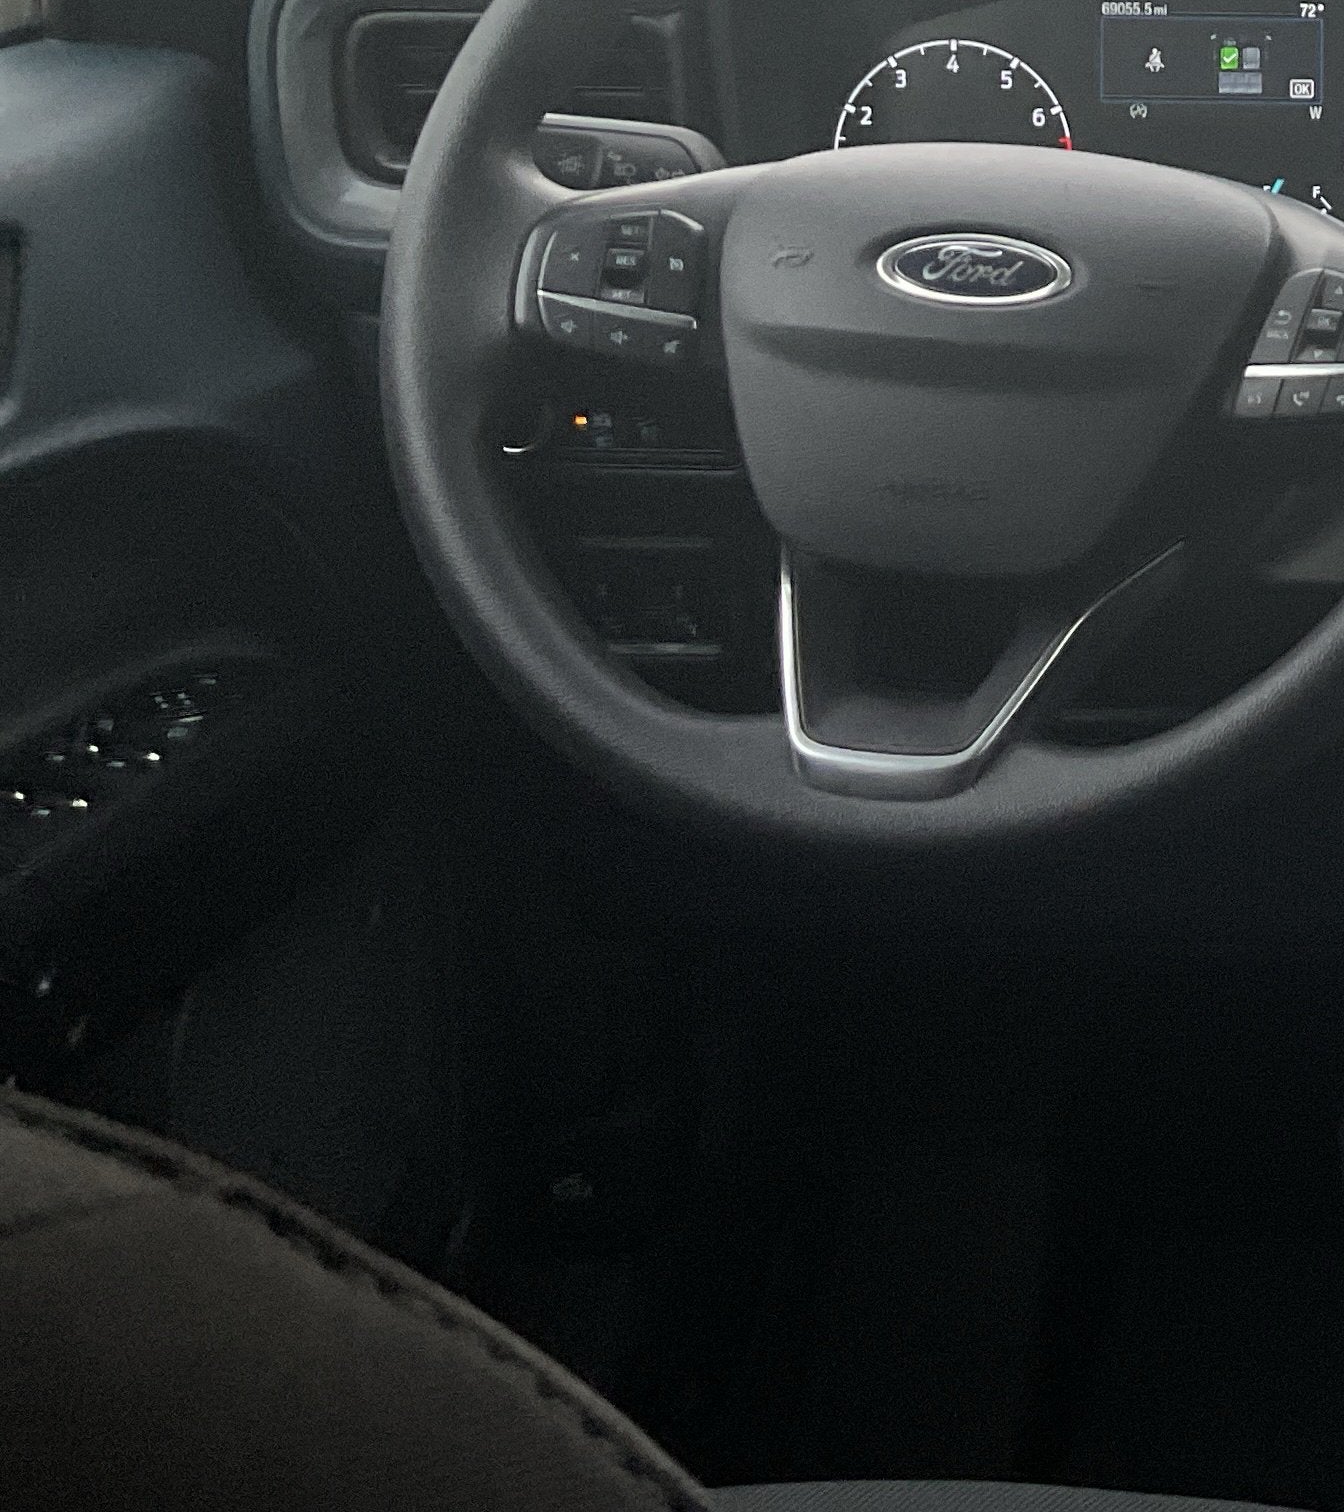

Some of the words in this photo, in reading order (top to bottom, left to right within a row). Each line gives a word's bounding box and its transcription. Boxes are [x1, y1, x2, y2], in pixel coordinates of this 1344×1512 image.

[1101, 1, 1153, 16] 69055.5
[1154, 3, 1168, 16] mi
[946, 54, 960, 73] 4
[894, 69, 907, 89] 3
[1000, 71, 1013, 89] 5
[1294, 83, 1310, 95] OK
[860, 105, 873, 126] 2
[1032, 107, 1046, 127] 6
[1309, 105, 1323, 120] W
[1312, 185, 1321, 199] F
[922, 245, 1024, 287] Ford
